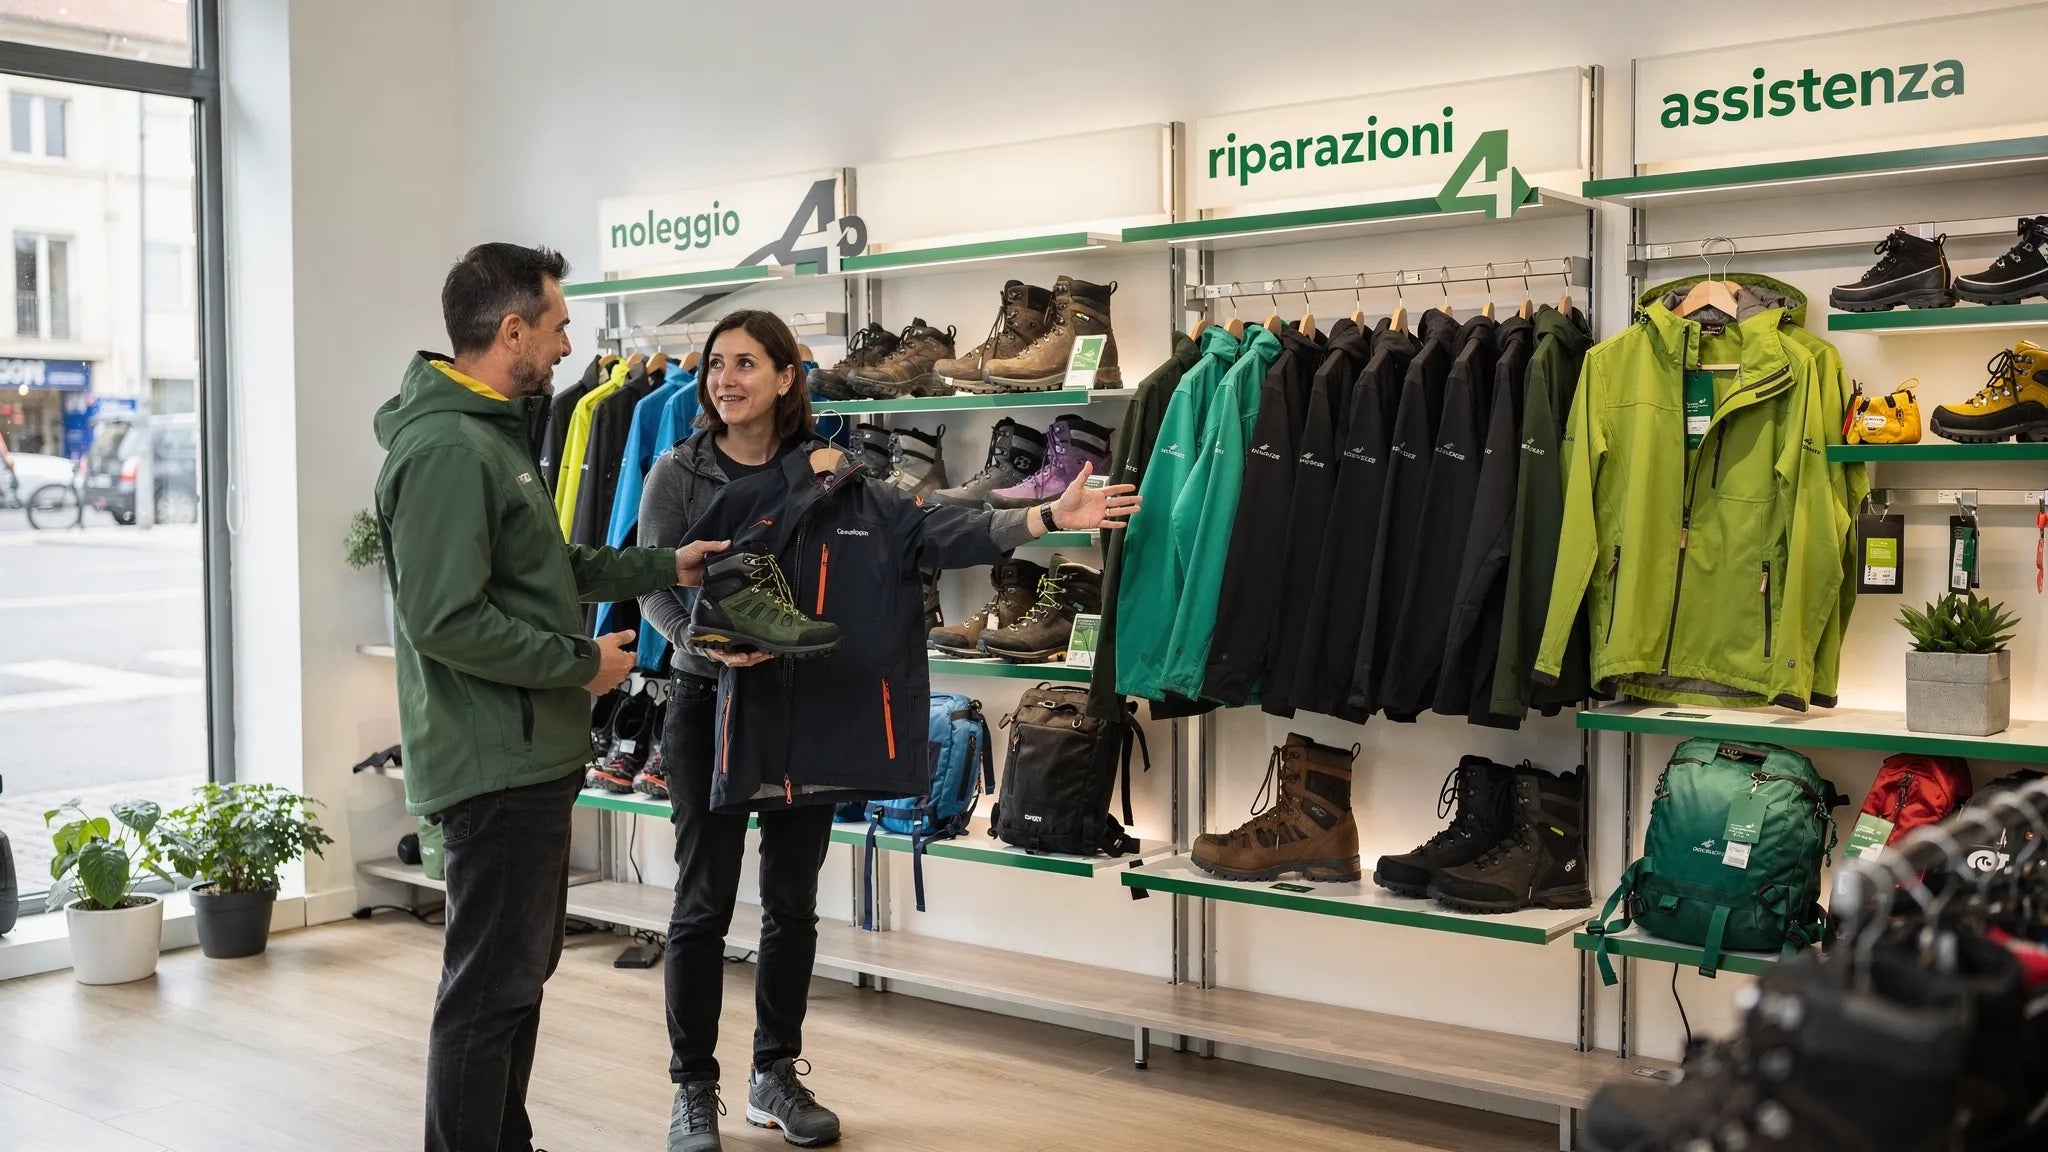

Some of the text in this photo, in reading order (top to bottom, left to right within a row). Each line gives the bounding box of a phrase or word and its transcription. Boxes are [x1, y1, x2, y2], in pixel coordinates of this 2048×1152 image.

[1660, 58, 1966, 130] assistenza
[1208, 106, 1455, 187] riparazioni
[610, 201, 741, 251] noleggio
